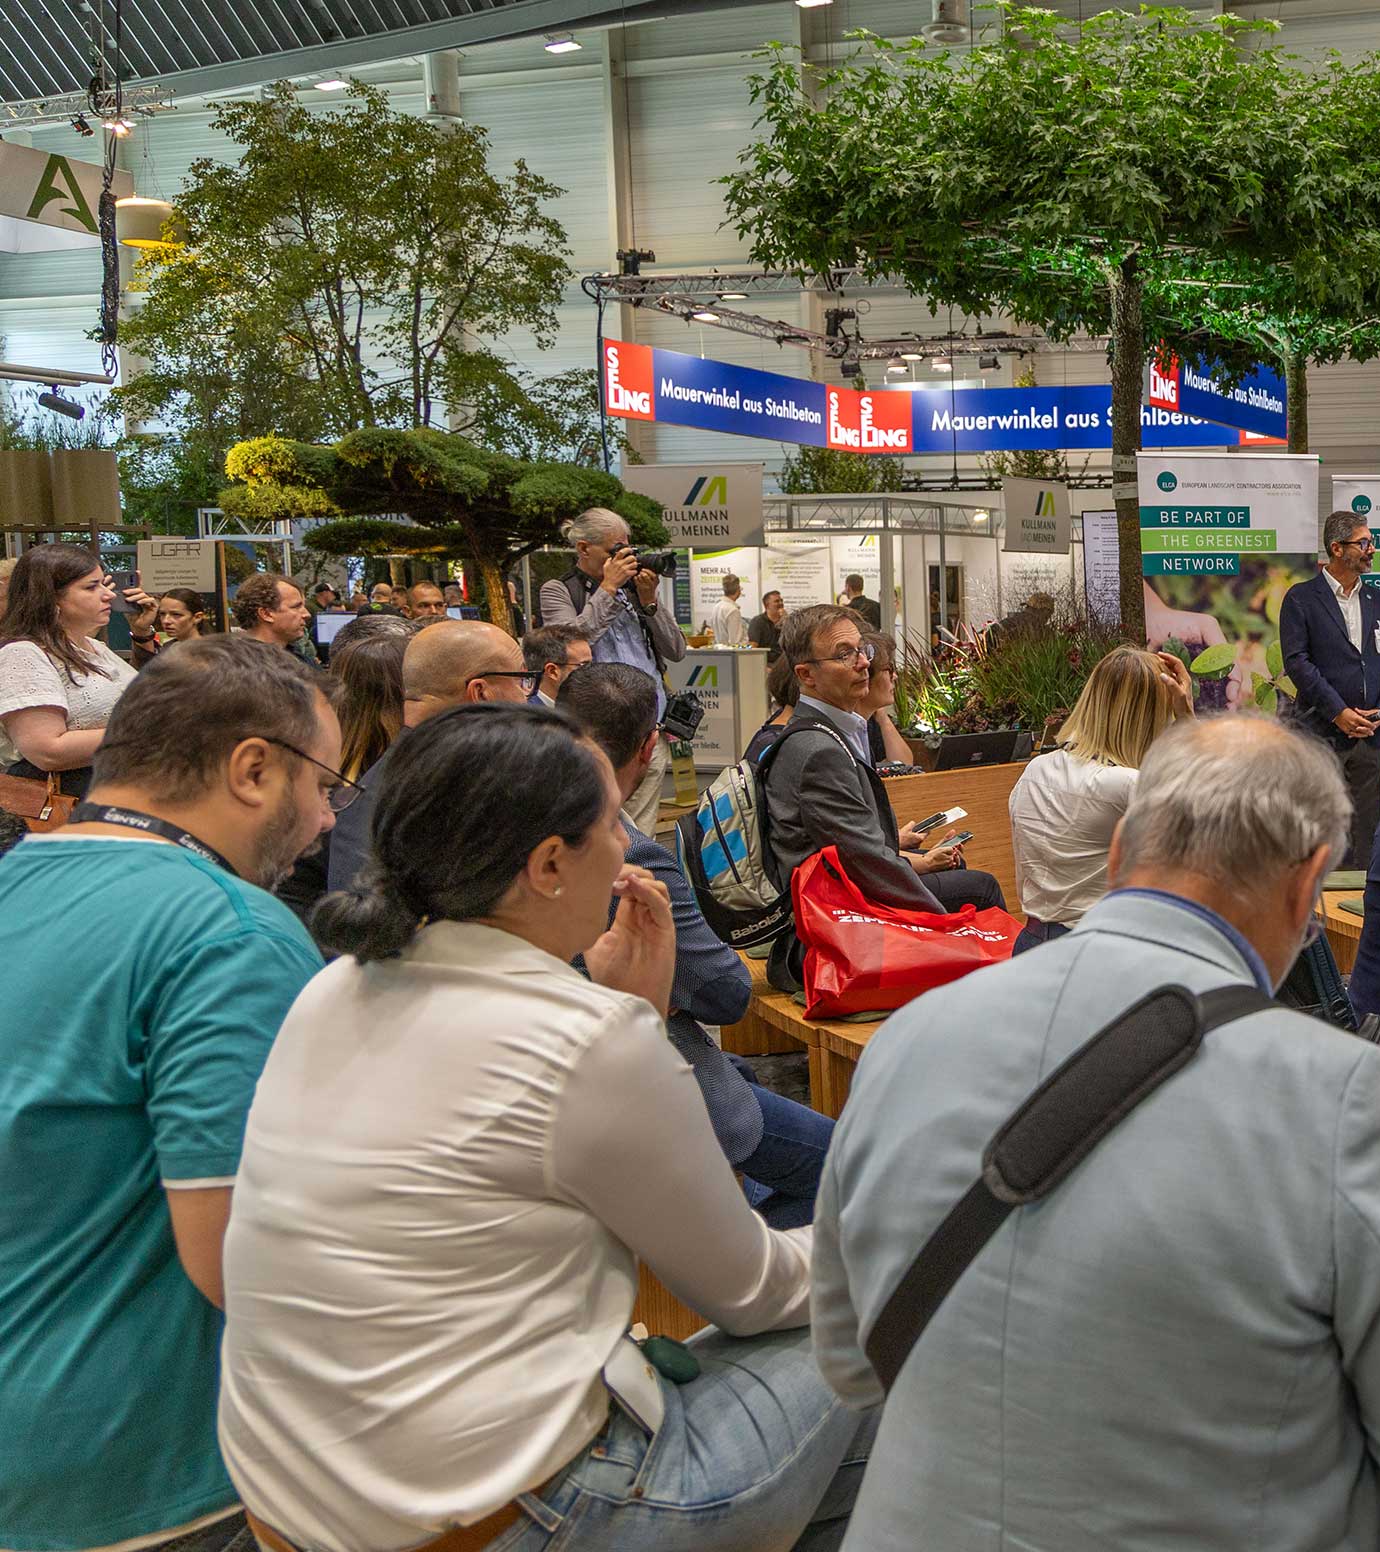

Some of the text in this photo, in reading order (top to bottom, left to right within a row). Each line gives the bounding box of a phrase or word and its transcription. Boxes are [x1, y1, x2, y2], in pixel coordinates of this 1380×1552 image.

[660, 377, 821, 425] Mauerwinkel aus Stahlbeton
[1234, 389, 1247, 405] aus
[1249, 387, 1283, 414] Stahlbeton
[931, 406, 1058, 431] Mauerwinkel
[1065, 411, 1100, 428] aus
[664, 510, 728, 521] ULLMANN
[1160, 511, 1245, 523] BE PART OF
[682, 525, 730, 536] MEINEN
[1022, 520, 1056, 529] KULLMANN
[1033, 533, 1055, 543] MEINEN
[1160, 534, 1271, 547] THE GREENEST
[1163, 558, 1234, 571] NETWORK
[731, 906, 782, 940] Babolat
